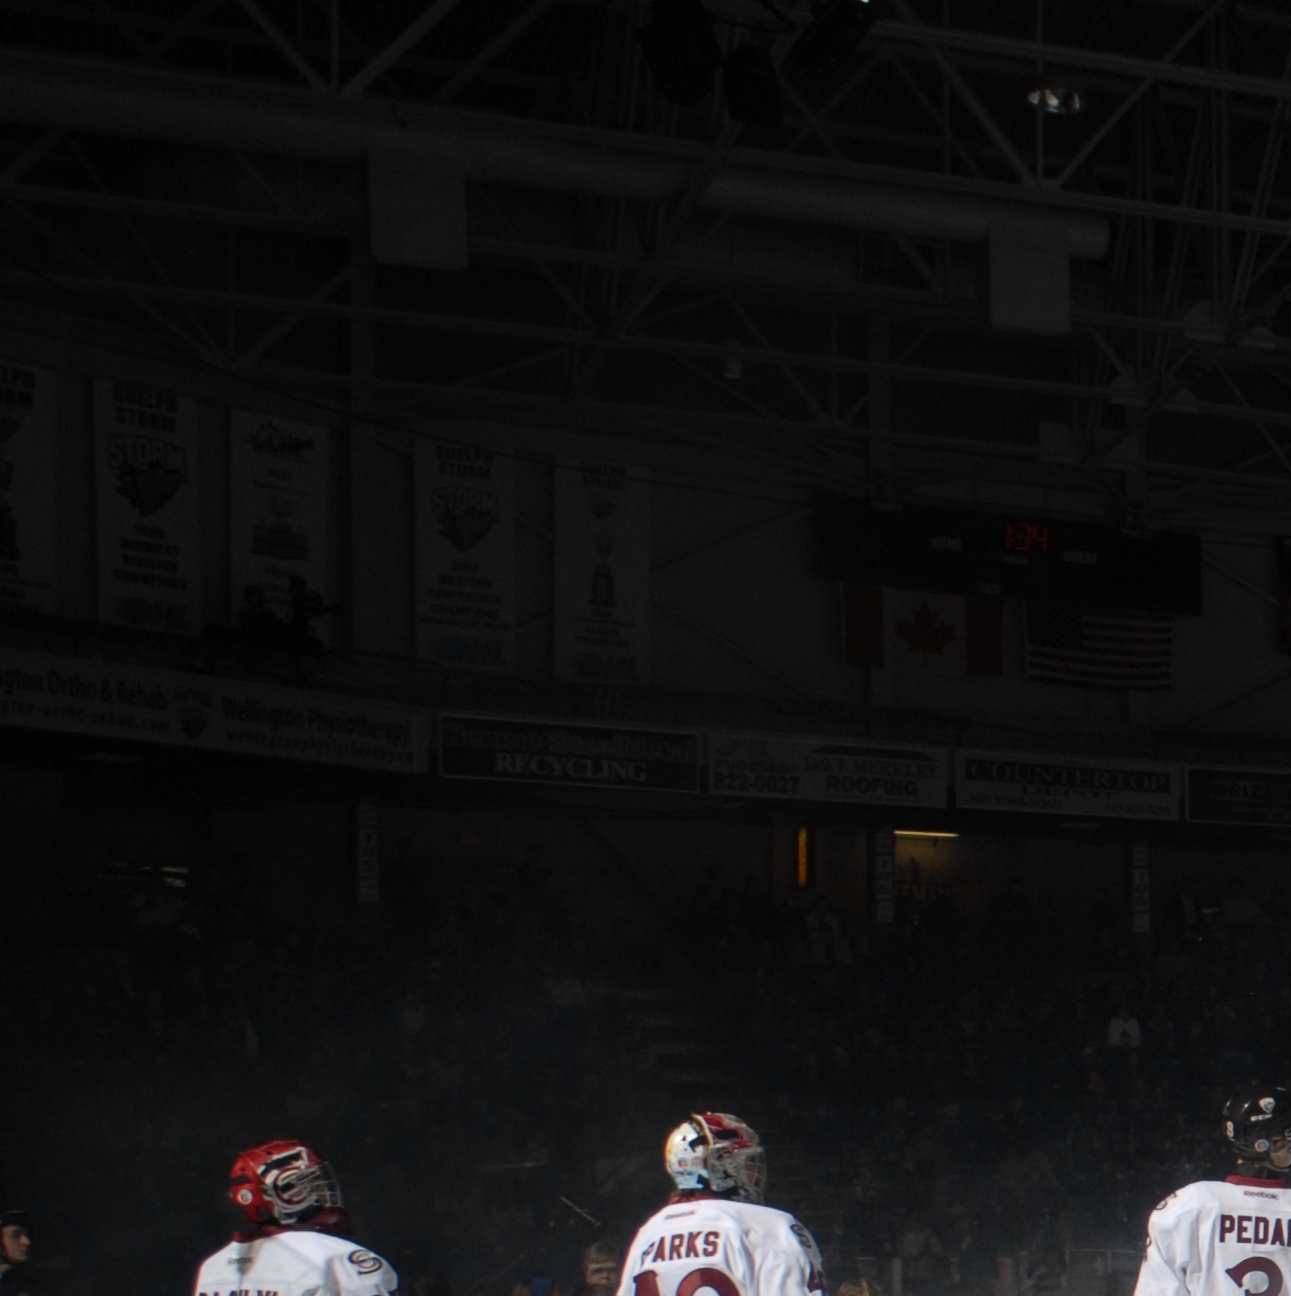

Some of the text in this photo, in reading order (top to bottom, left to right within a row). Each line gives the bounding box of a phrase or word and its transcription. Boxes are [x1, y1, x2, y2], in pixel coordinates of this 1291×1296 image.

[116, 406, 176, 433] STORM
[435, 445, 494, 464] GUELPH
[438, 461, 492, 480] STORM
[930, 536, 1097, 565] HOME GUEST
[48, 671, 97, 701] Ortho
[100, 679, 113, 700] &
[116, 680, 168, 711] Rehab
[222, 695, 410, 748] Wellington Physiotherapy
[495, 751, 648, 783] RECYCLING
[803, 756, 939, 779] DAVE MERKLEY
[970, 762, 1166, 791] COUNTERTOP
[713, 771, 800, 795] 822-0027
[825, 775, 919, 797] ROOFING
[1021, 784, 1120, 801] DEPOT
[642, 1230, 721, 1265] PARKS
